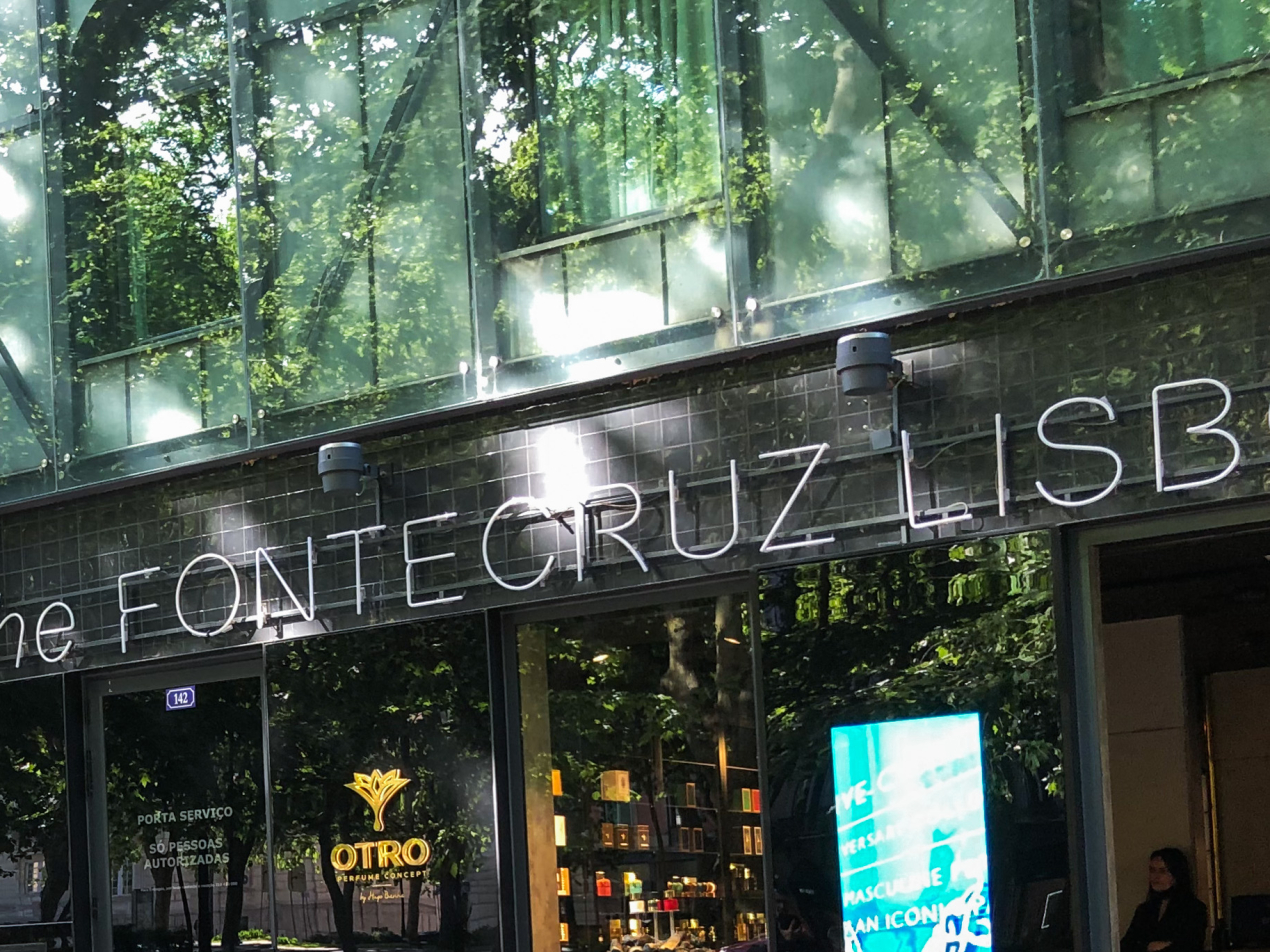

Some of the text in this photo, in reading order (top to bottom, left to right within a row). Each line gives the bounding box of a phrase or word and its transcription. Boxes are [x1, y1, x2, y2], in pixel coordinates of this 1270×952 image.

[119, 442, 837, 654] FONTECRUZ
[900, 377, 1270, 529] LISB
[173, 692, 189, 706] 142
[137, 806, 234, 826] PORTA SERVIÇO
[168, 837, 224, 853] PESSOAS
[330, 837, 431, 871] OTRO
[143, 852, 231, 871] AUTORIZADAS
[336, 870, 427, 883] PERFUME CONCEPT
